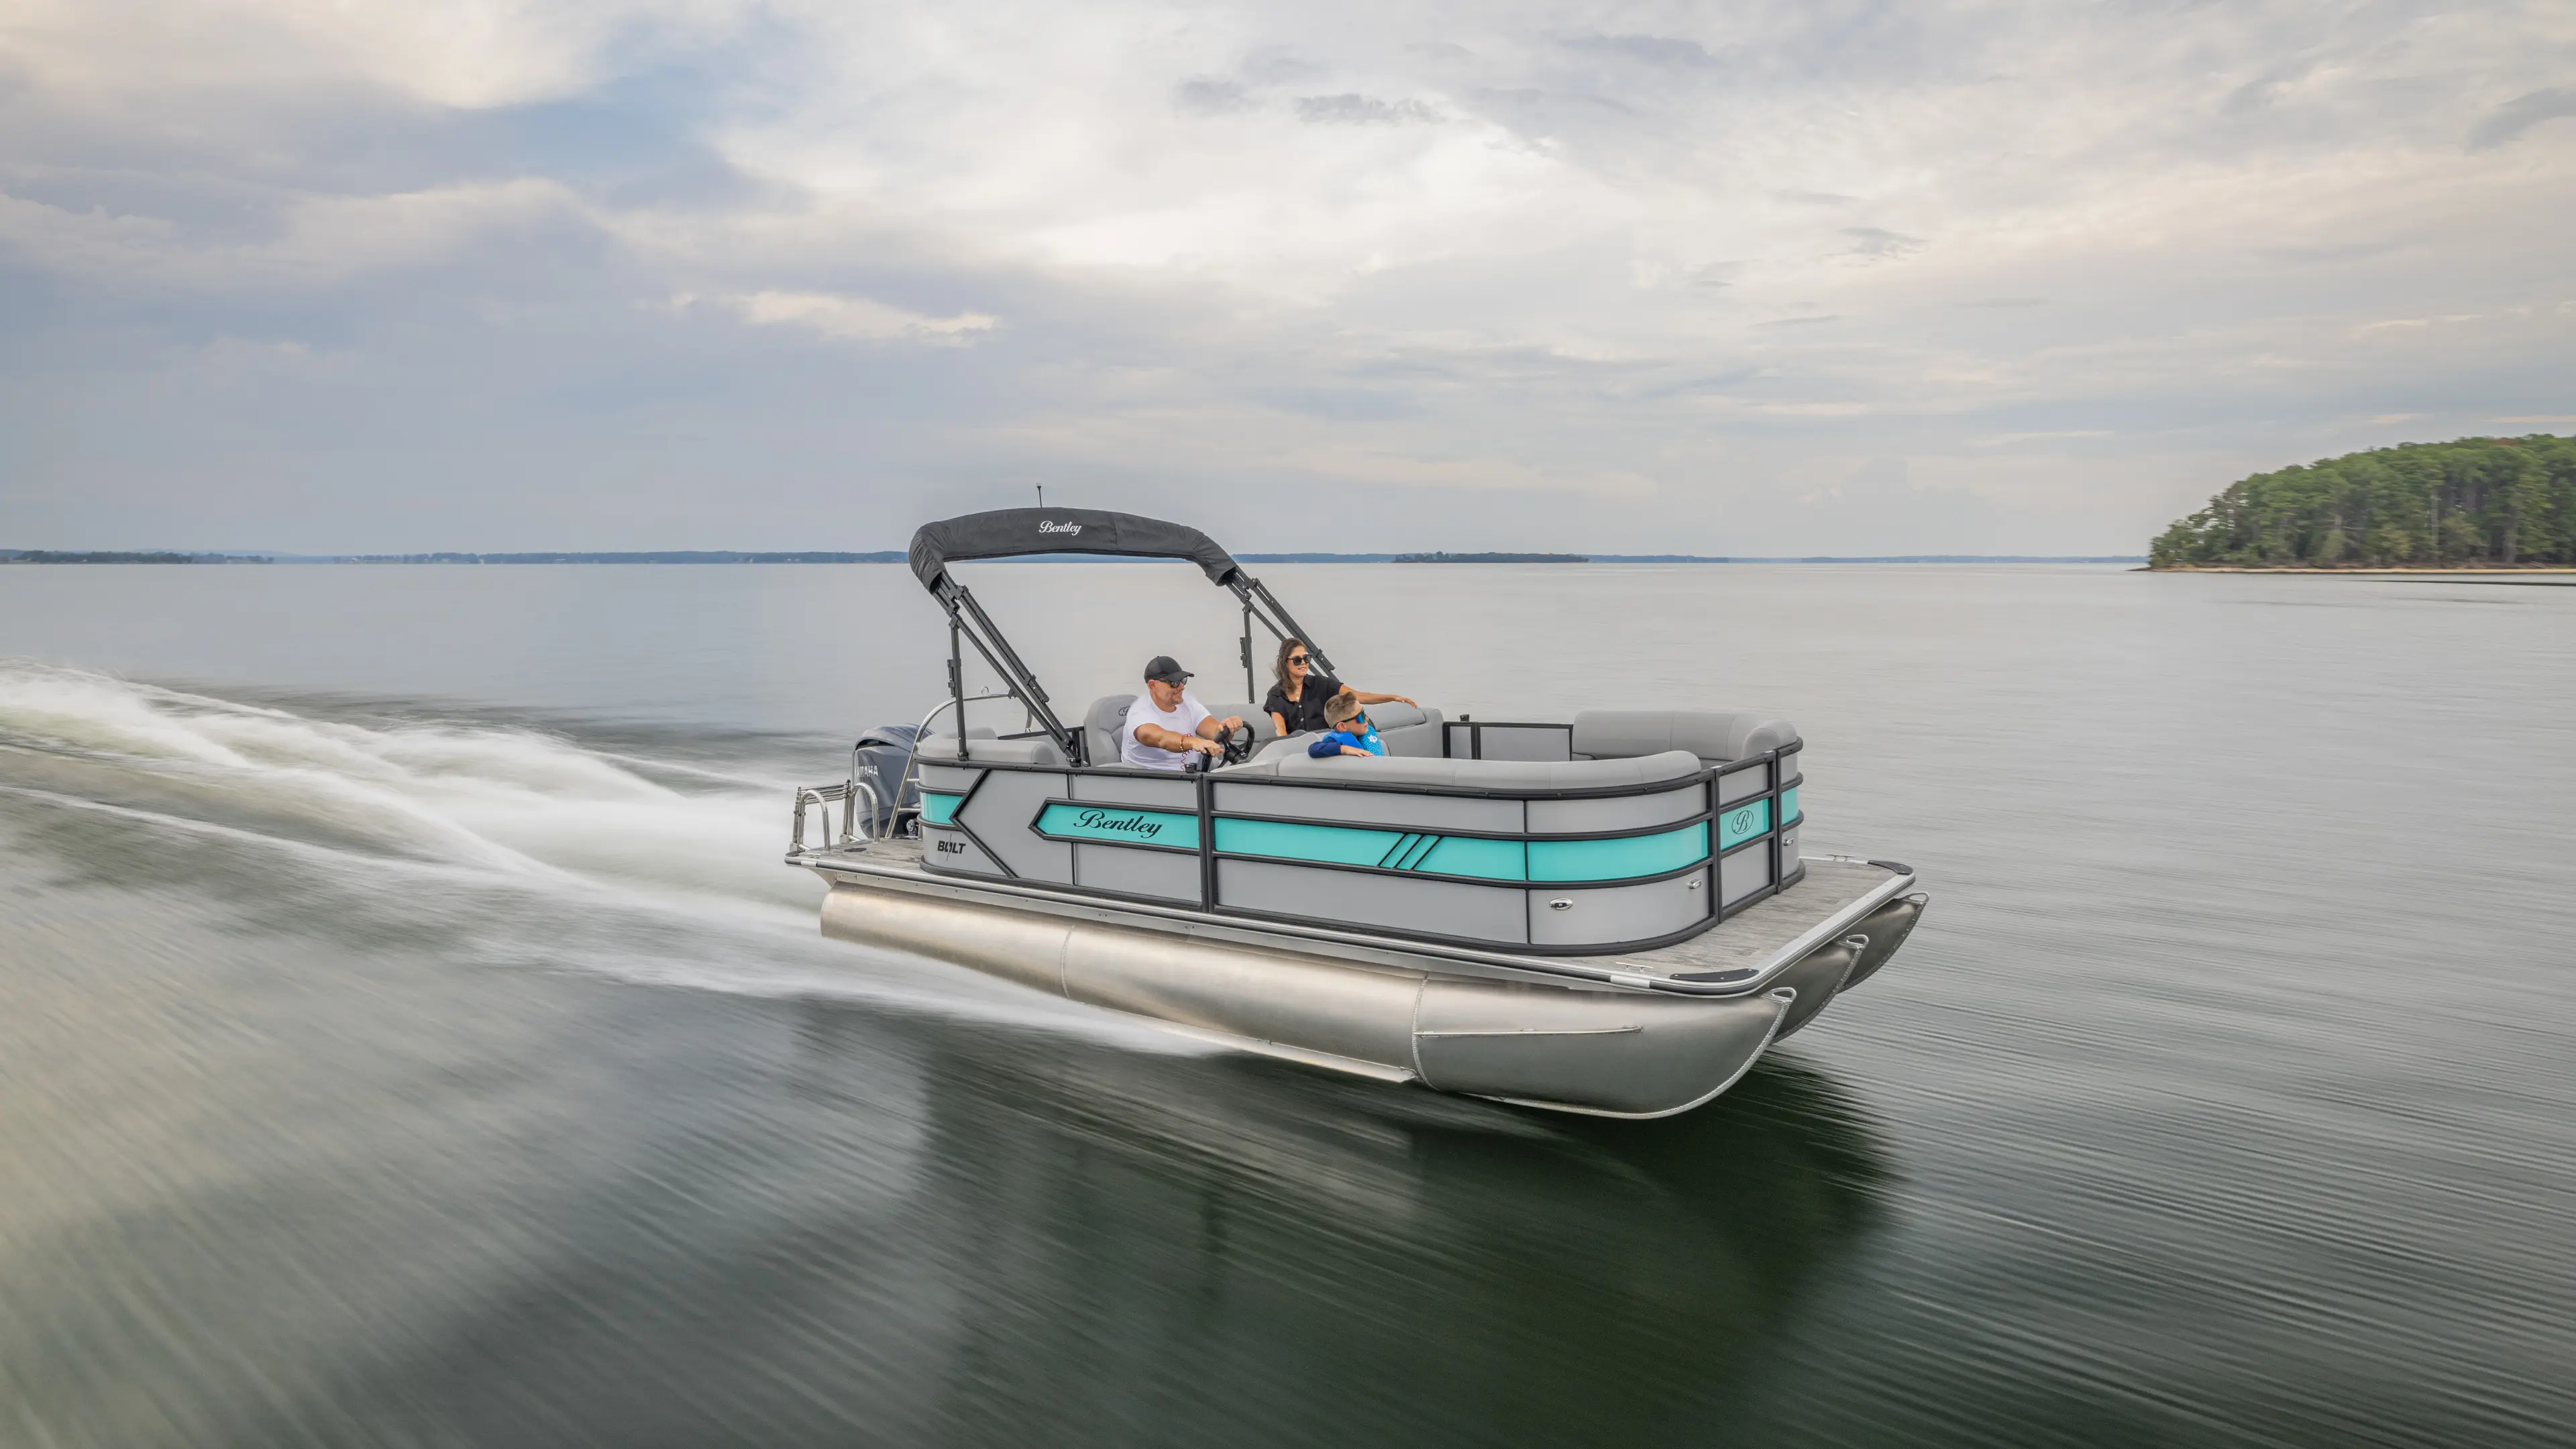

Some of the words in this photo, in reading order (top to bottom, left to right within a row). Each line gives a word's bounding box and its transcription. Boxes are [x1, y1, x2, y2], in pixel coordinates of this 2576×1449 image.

[1038, 520, 1082, 536] Bentley
[1073, 809, 1163, 839] Bentley
[937, 840, 967, 855] BOLT
